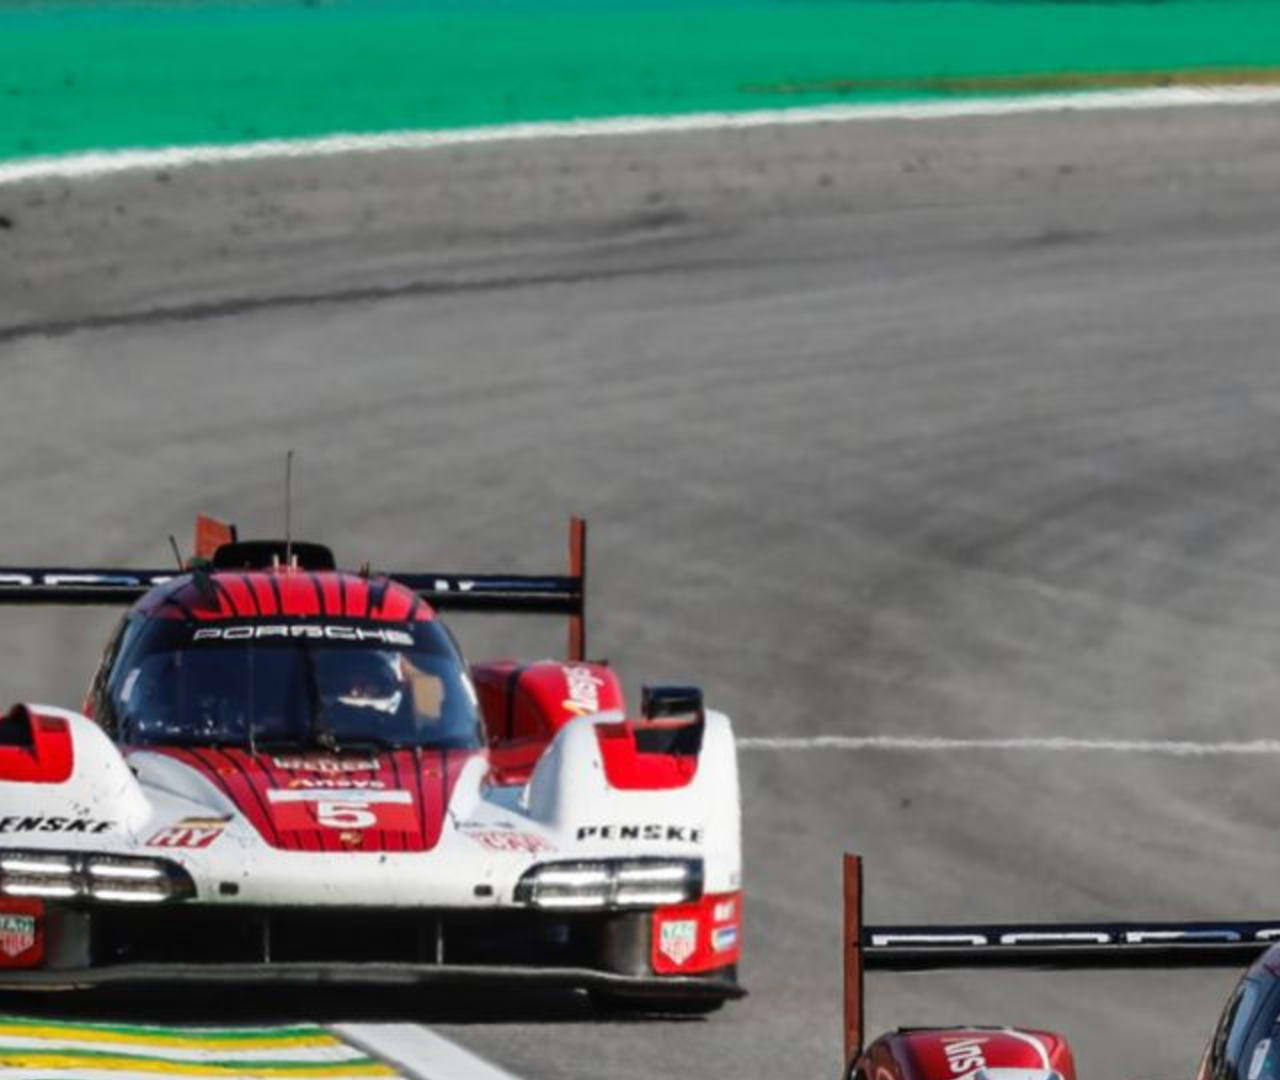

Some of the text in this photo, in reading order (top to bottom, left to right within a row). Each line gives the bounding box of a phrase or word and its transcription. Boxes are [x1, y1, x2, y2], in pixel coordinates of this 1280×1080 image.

[193, 625, 414, 645] PORSCHE
[317, 802, 377, 829] 5
[577, 824, 704, 842] PENSKE
